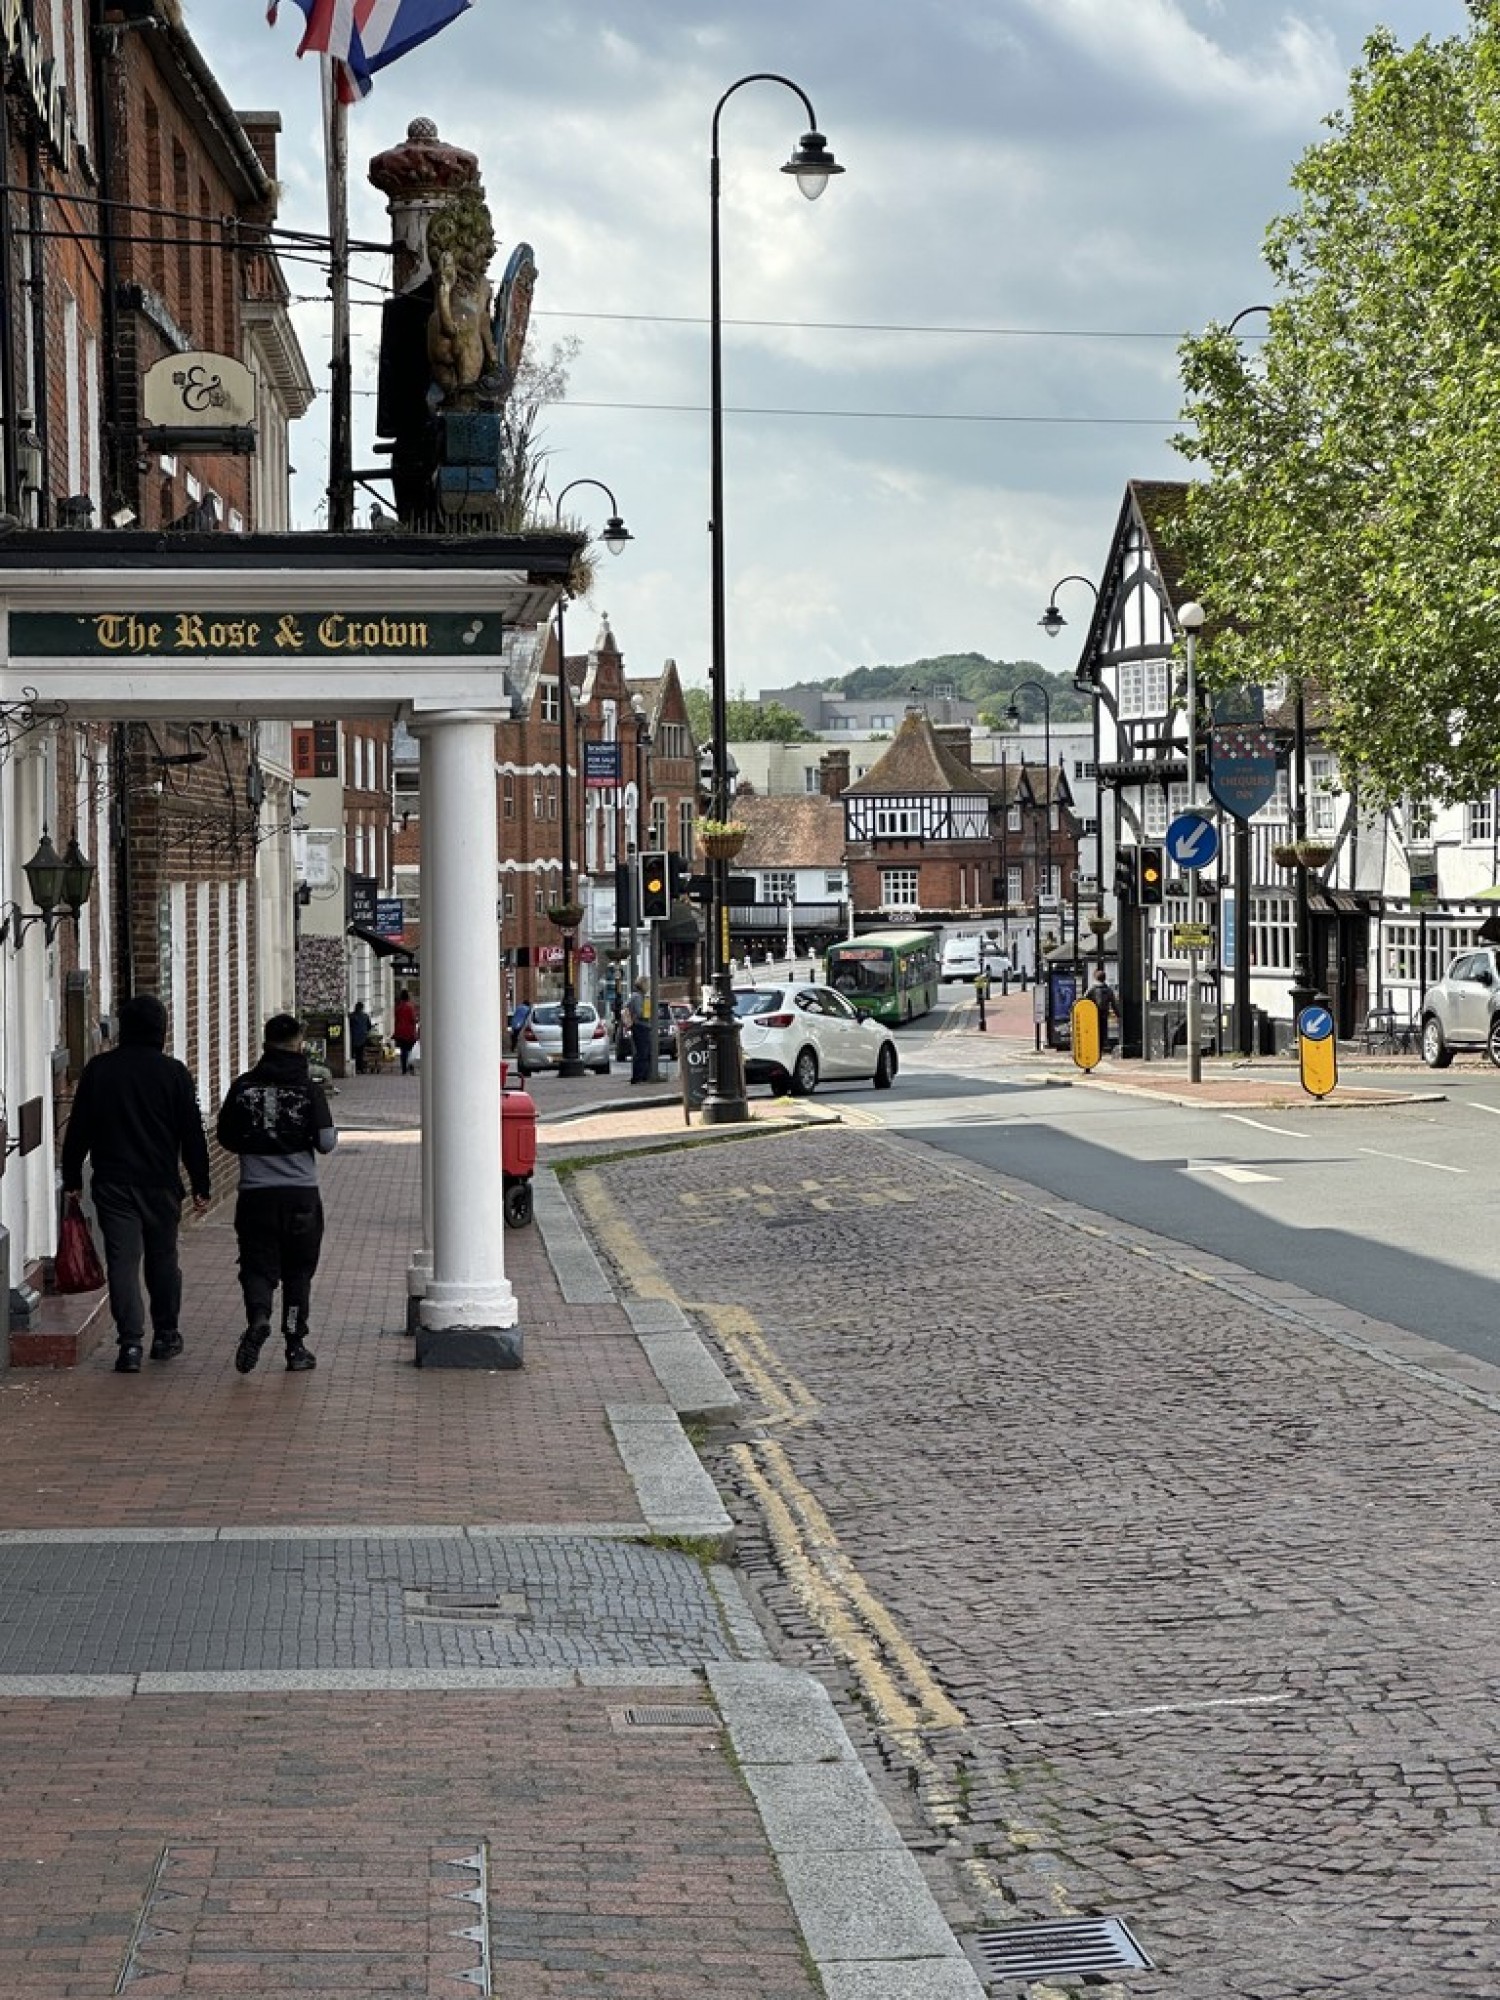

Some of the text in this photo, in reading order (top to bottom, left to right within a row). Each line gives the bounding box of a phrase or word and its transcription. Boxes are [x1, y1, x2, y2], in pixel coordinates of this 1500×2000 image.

[92, 612, 429, 652] The Rose & Crown
[1220, 776, 1270, 787] CHEQUERS
